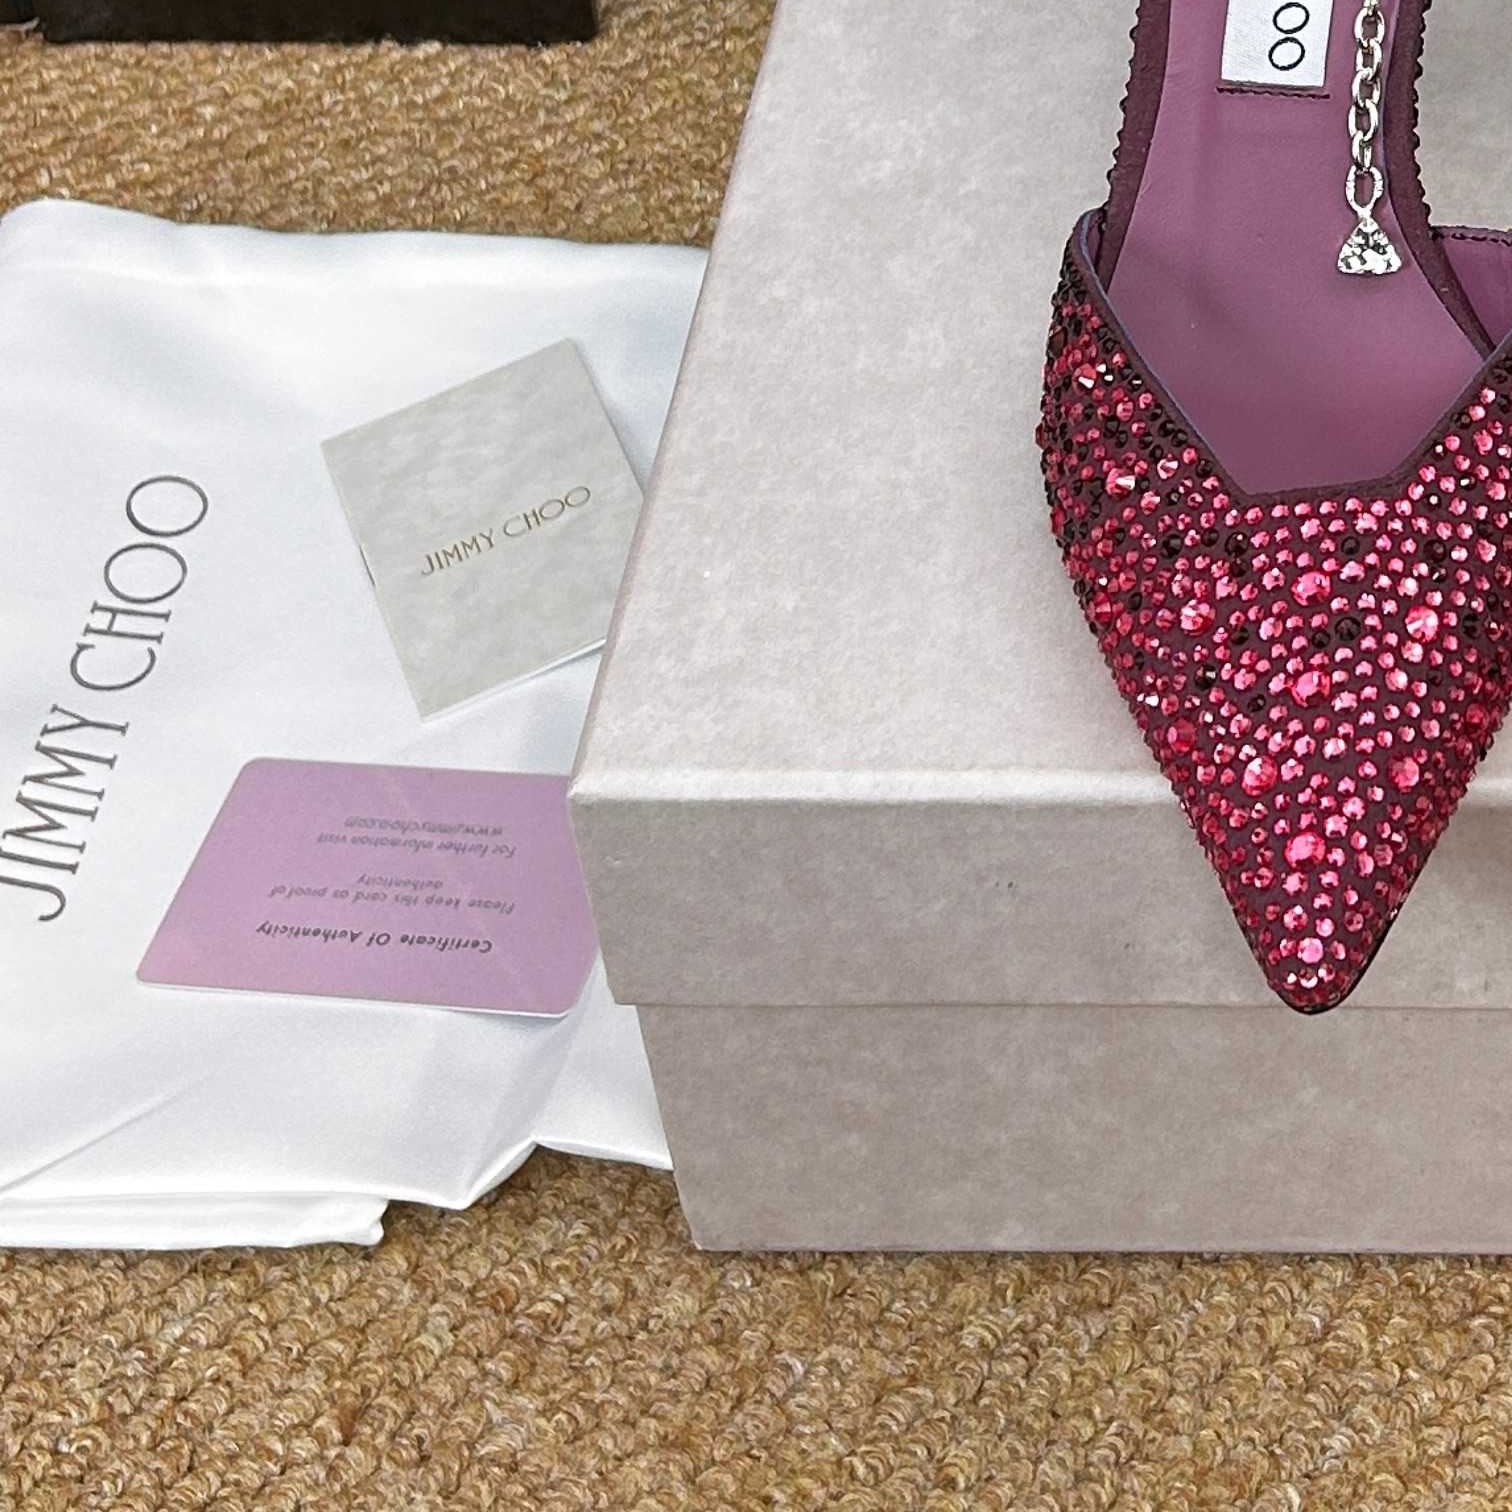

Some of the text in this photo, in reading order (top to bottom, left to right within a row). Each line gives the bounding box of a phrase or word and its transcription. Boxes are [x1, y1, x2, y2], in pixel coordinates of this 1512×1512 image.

[420, 485, 592, 577] JIMMY CHOO
[0, 474, 209, 922] JIMMY CHOO
[256, 920, 493, 954] Certificate Of Authenticity
[467, 898, 515, 915] Please
